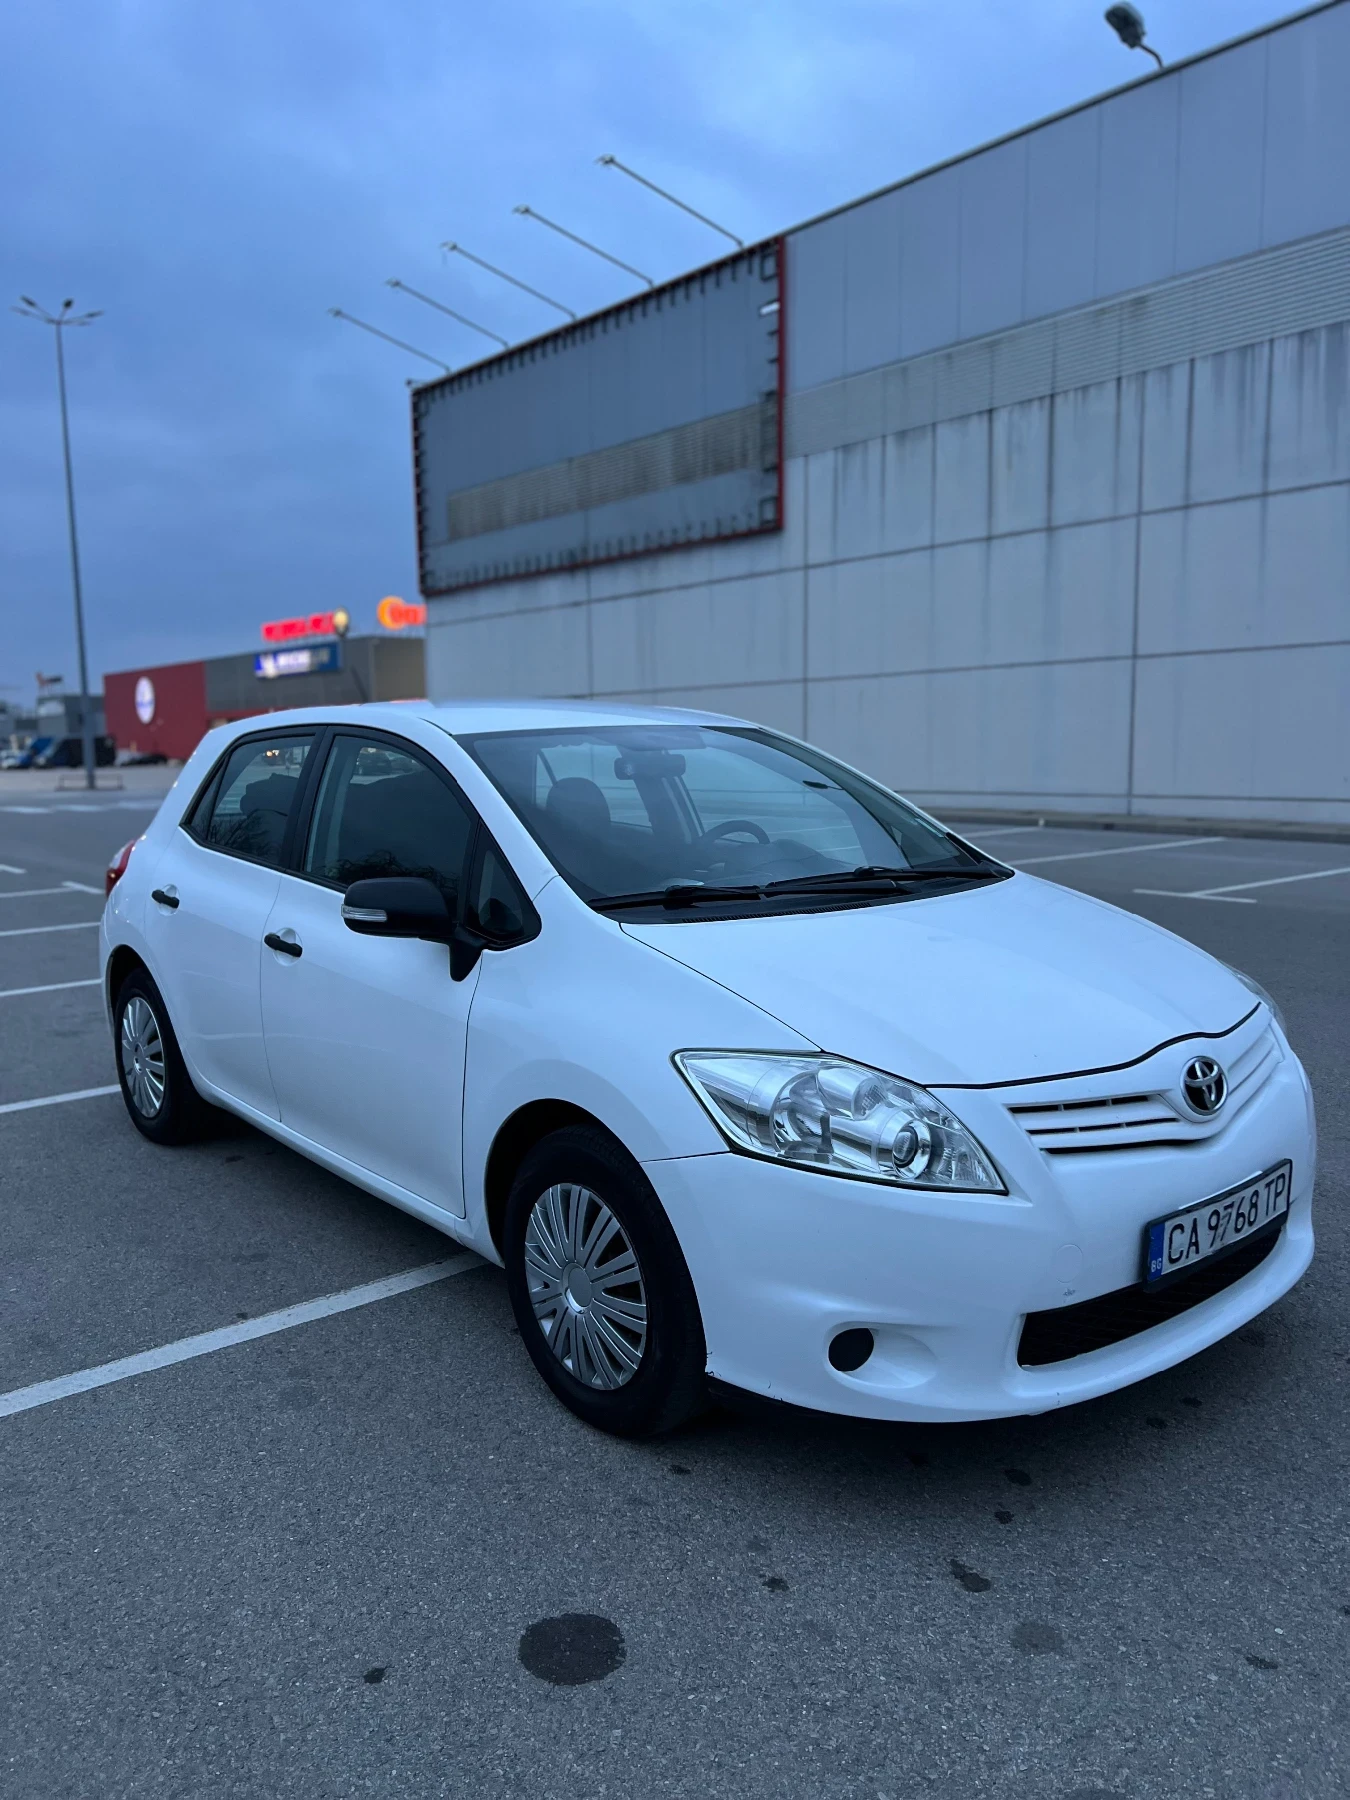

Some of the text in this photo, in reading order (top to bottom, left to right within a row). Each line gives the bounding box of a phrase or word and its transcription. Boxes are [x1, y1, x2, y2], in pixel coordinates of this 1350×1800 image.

[1168, 1172, 1286, 1264] CA 9768 TP
[1151, 1257, 1162, 1273] BG
